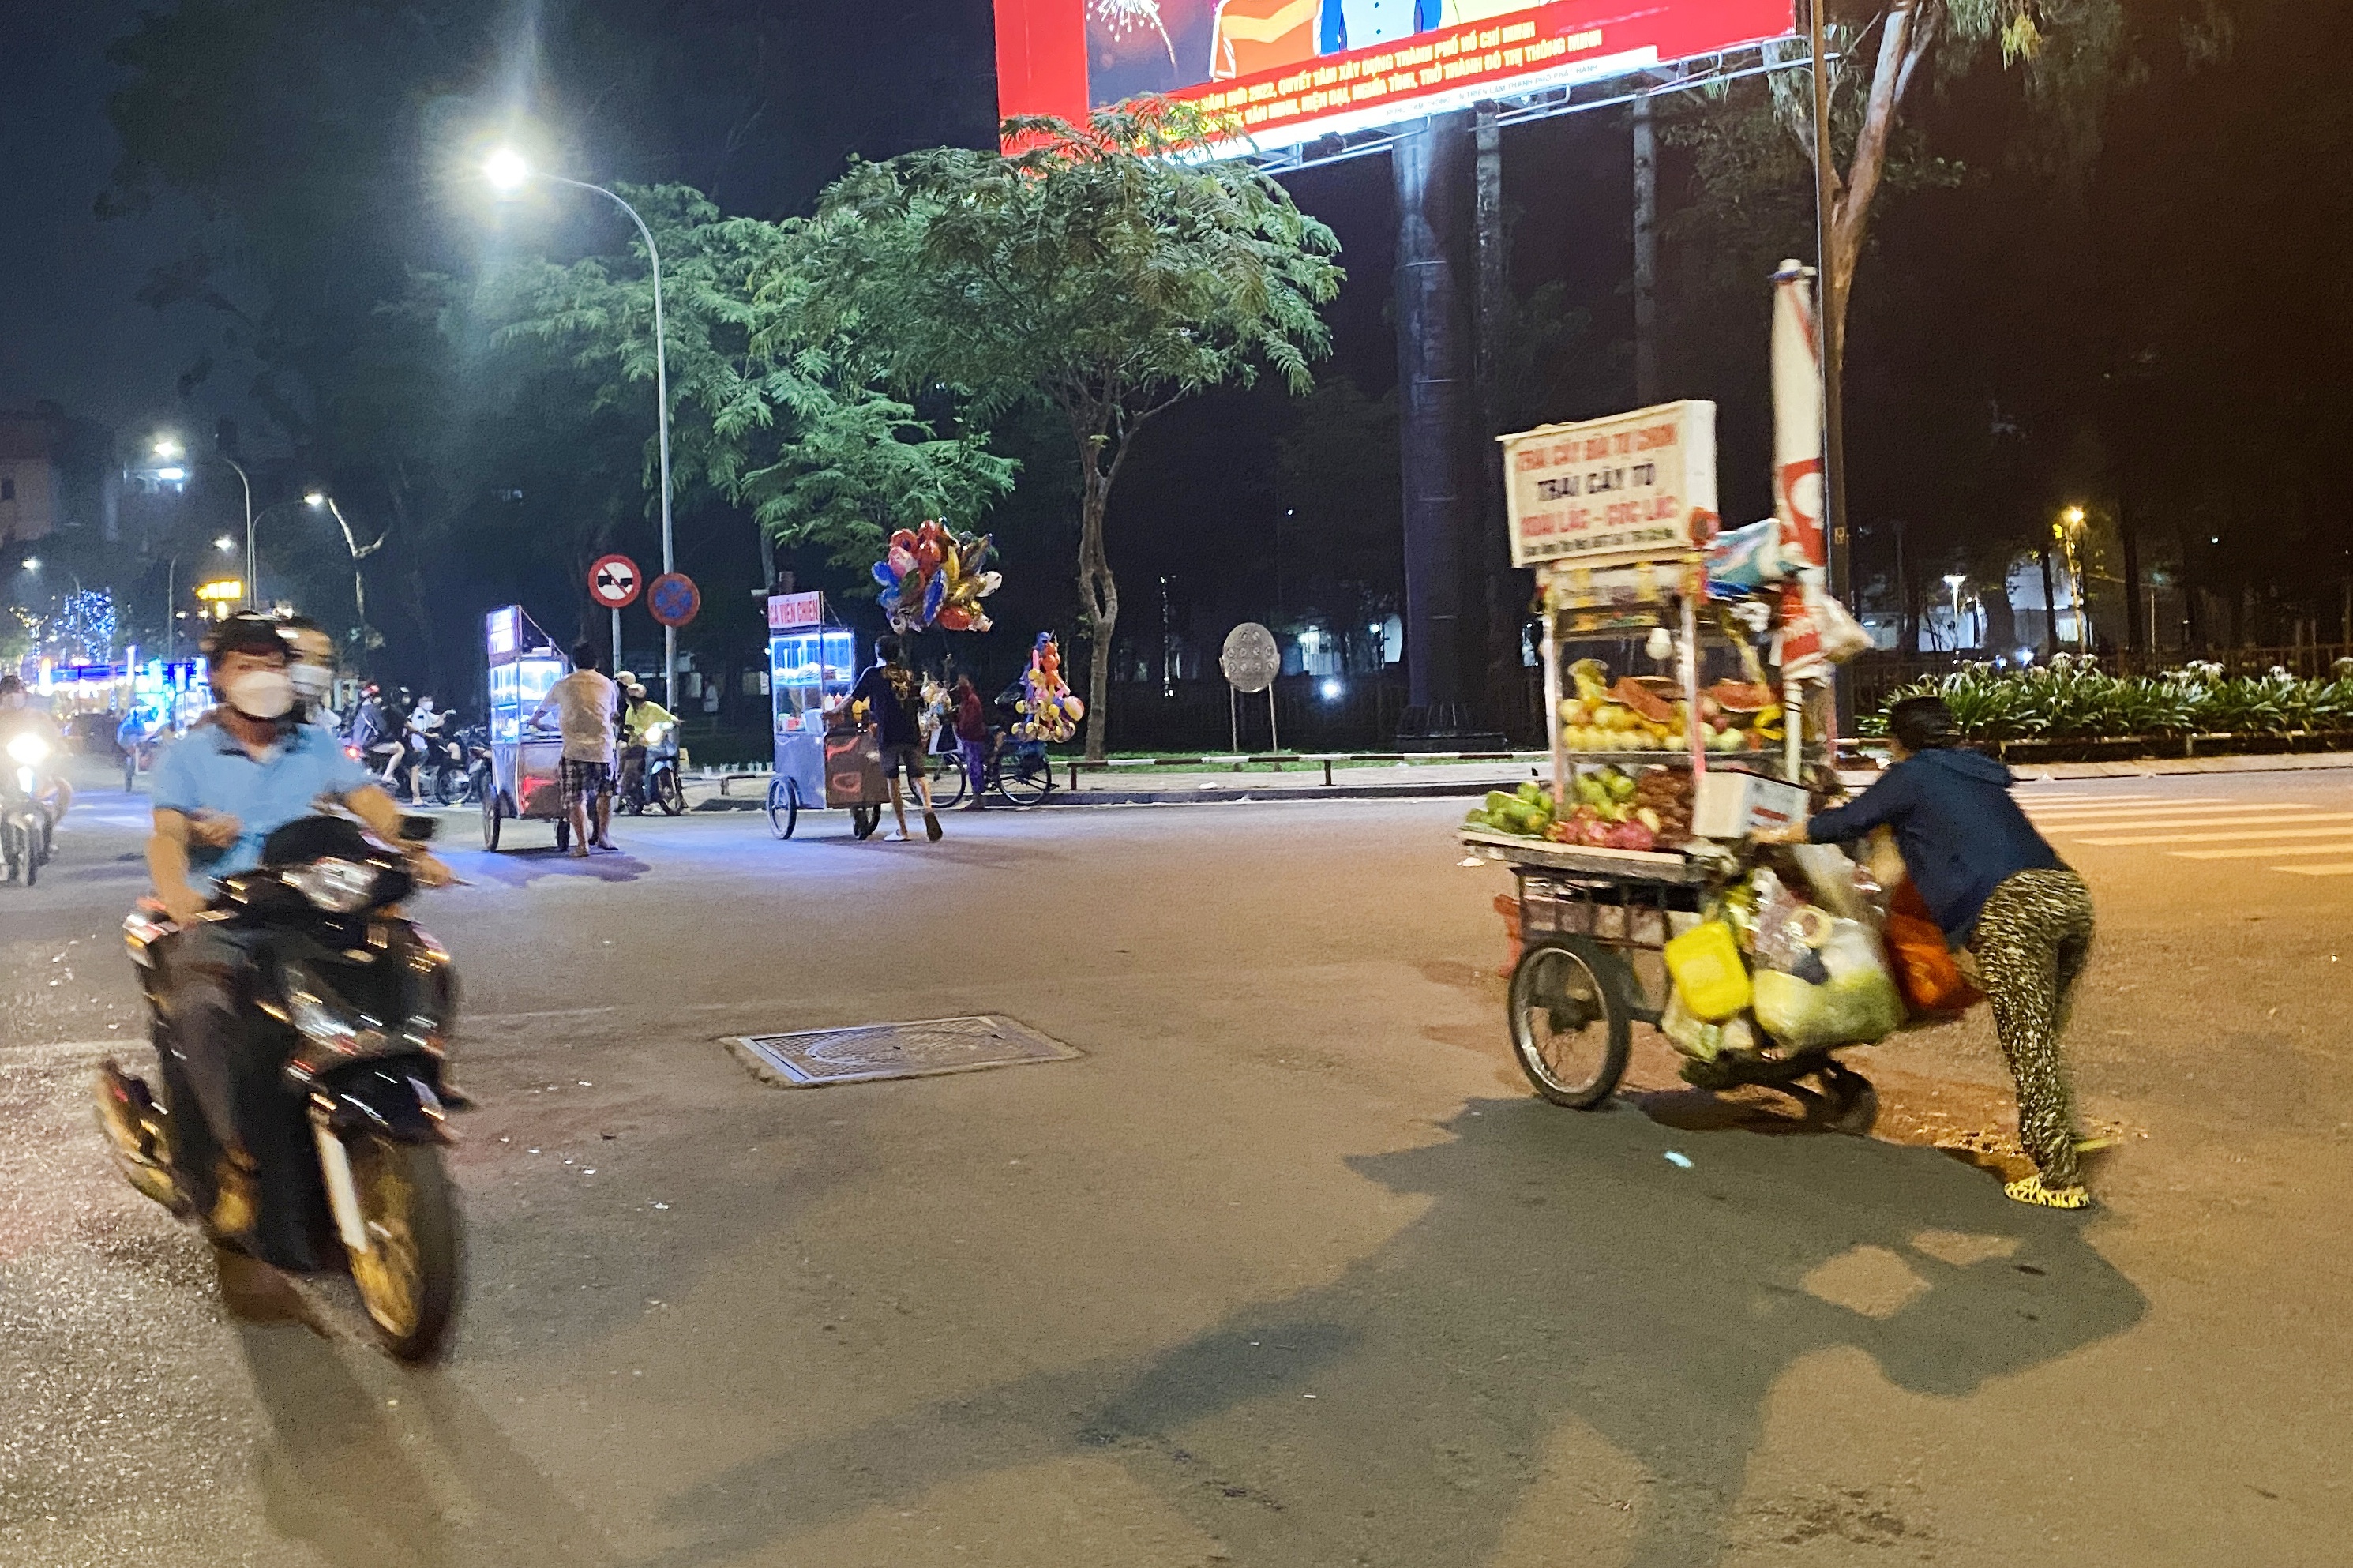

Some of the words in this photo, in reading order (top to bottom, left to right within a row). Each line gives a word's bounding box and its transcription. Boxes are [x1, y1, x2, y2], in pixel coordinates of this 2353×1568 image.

[1395, 46, 1433, 68] THÀNH
[1434, 33, 1459, 58] PHỐ
[1479, 26, 1500, 48] CHÍ
[1502, 21, 1536, 44] MINH
[1443, 57, 1483, 81] THÀNH
[1503, 47, 1523, 68] THỊ
[1525, 38, 1566, 62] THÔNG
[1567, 29, 1602, 53] MINH
